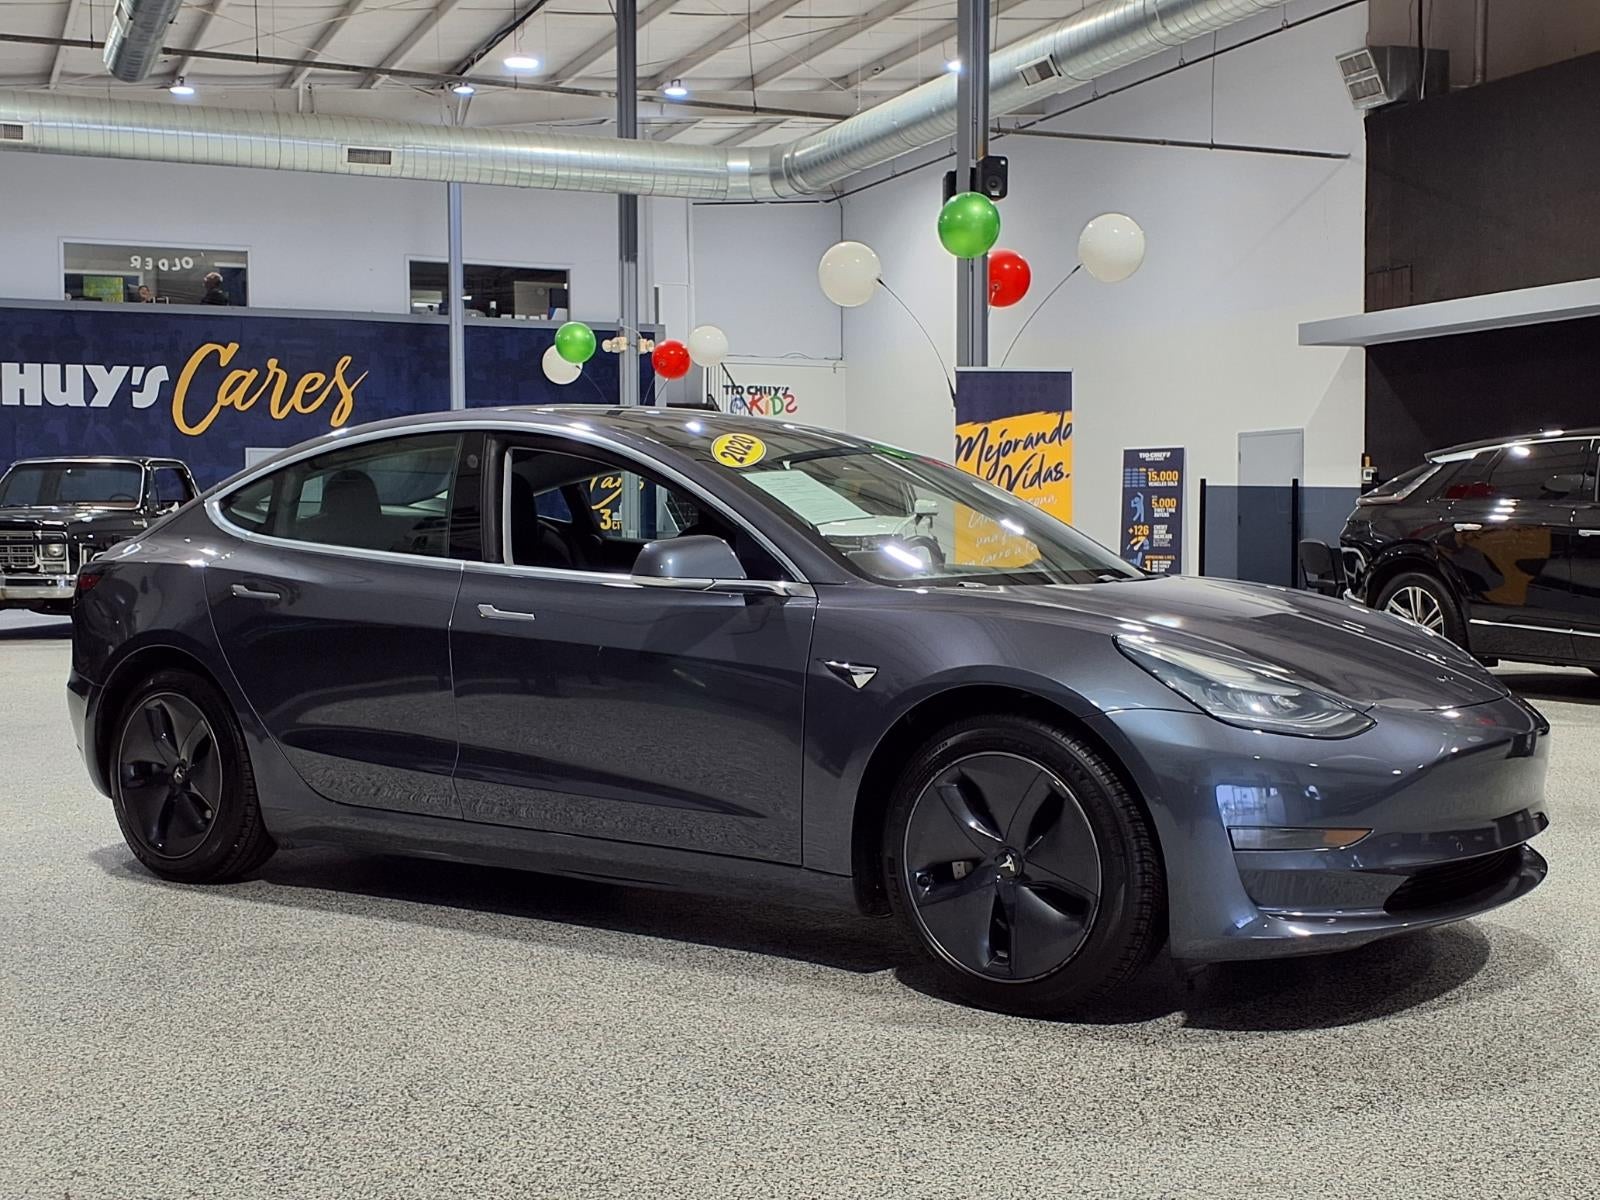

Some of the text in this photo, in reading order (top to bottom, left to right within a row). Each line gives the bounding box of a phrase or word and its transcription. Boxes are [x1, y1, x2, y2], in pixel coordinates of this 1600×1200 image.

[172, 342, 369, 436] Cares
[720, 435, 756, 464] 2020
[956, 411, 1072, 481] Mejorando
[600, 508, 612, 530] 3
